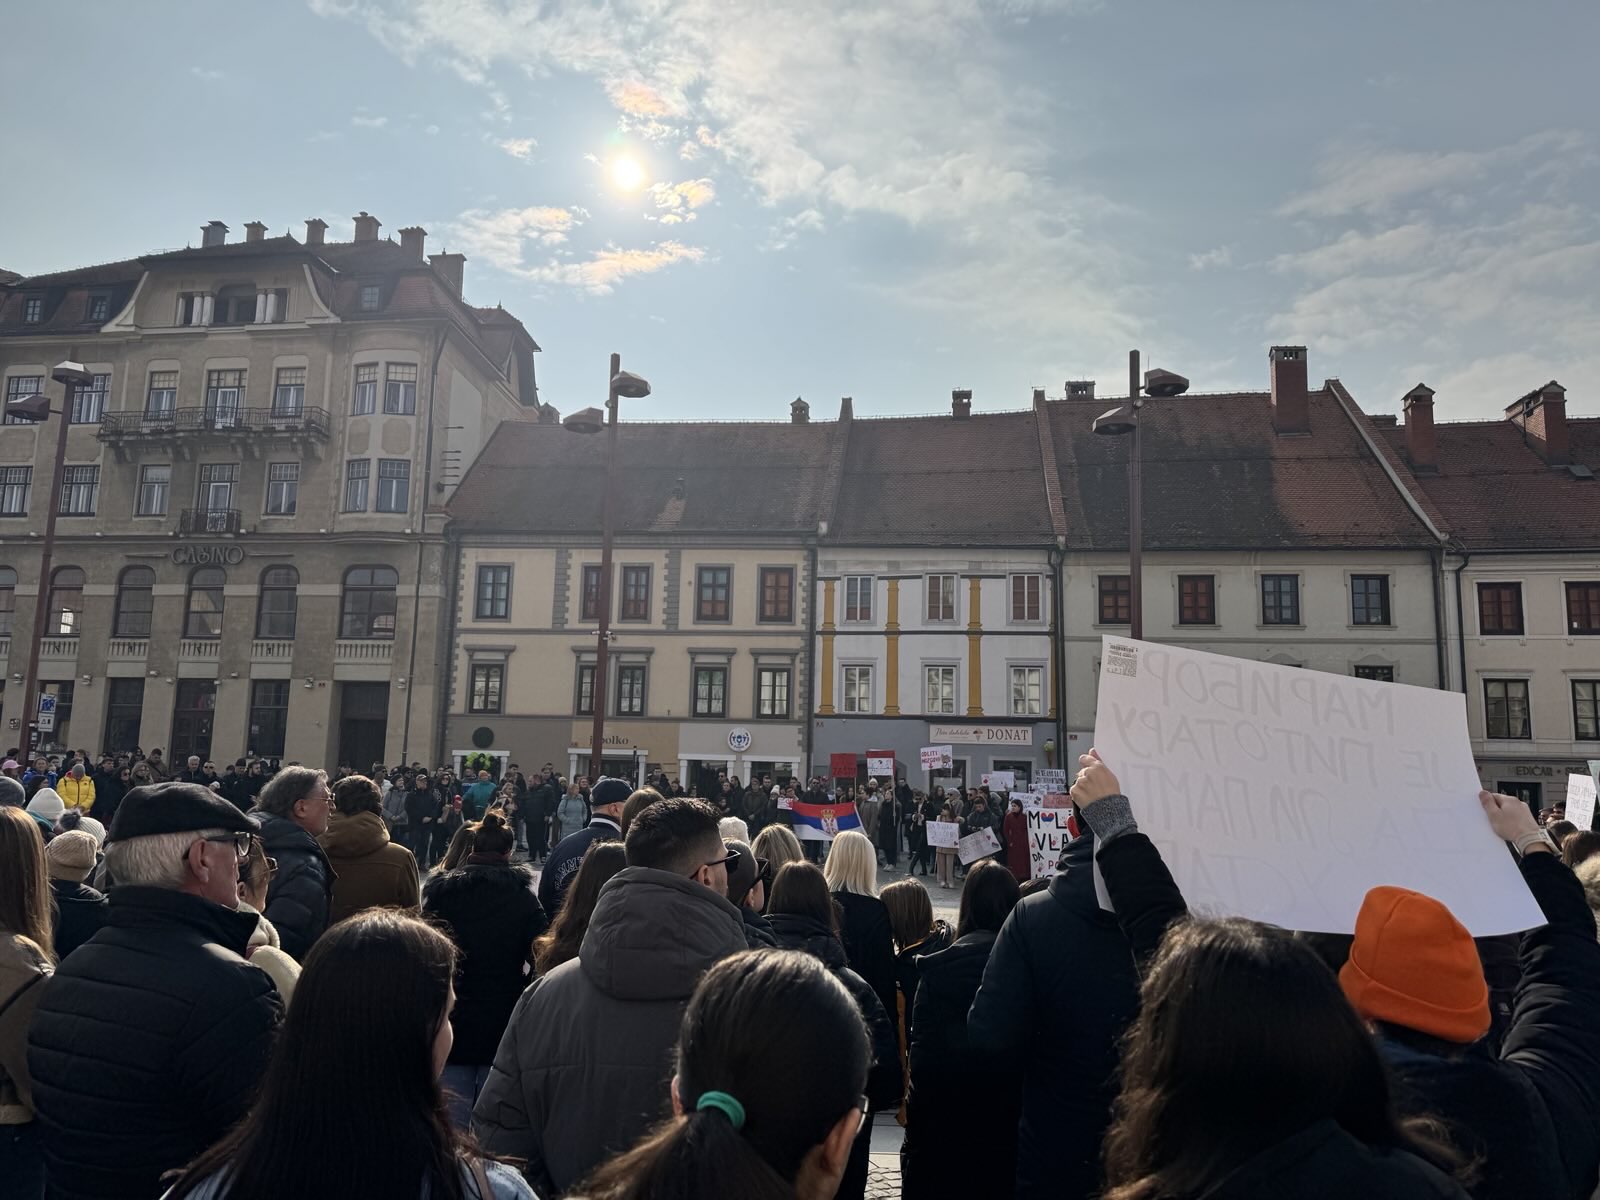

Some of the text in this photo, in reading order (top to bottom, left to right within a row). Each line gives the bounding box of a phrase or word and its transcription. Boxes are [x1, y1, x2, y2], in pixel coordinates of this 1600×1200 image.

[171, 546, 244, 565] CASINO
[588, 735, 629, 746] jolko
[987, 728, 1029, 741] DONAT
[1032, 852, 1045, 862] DA
